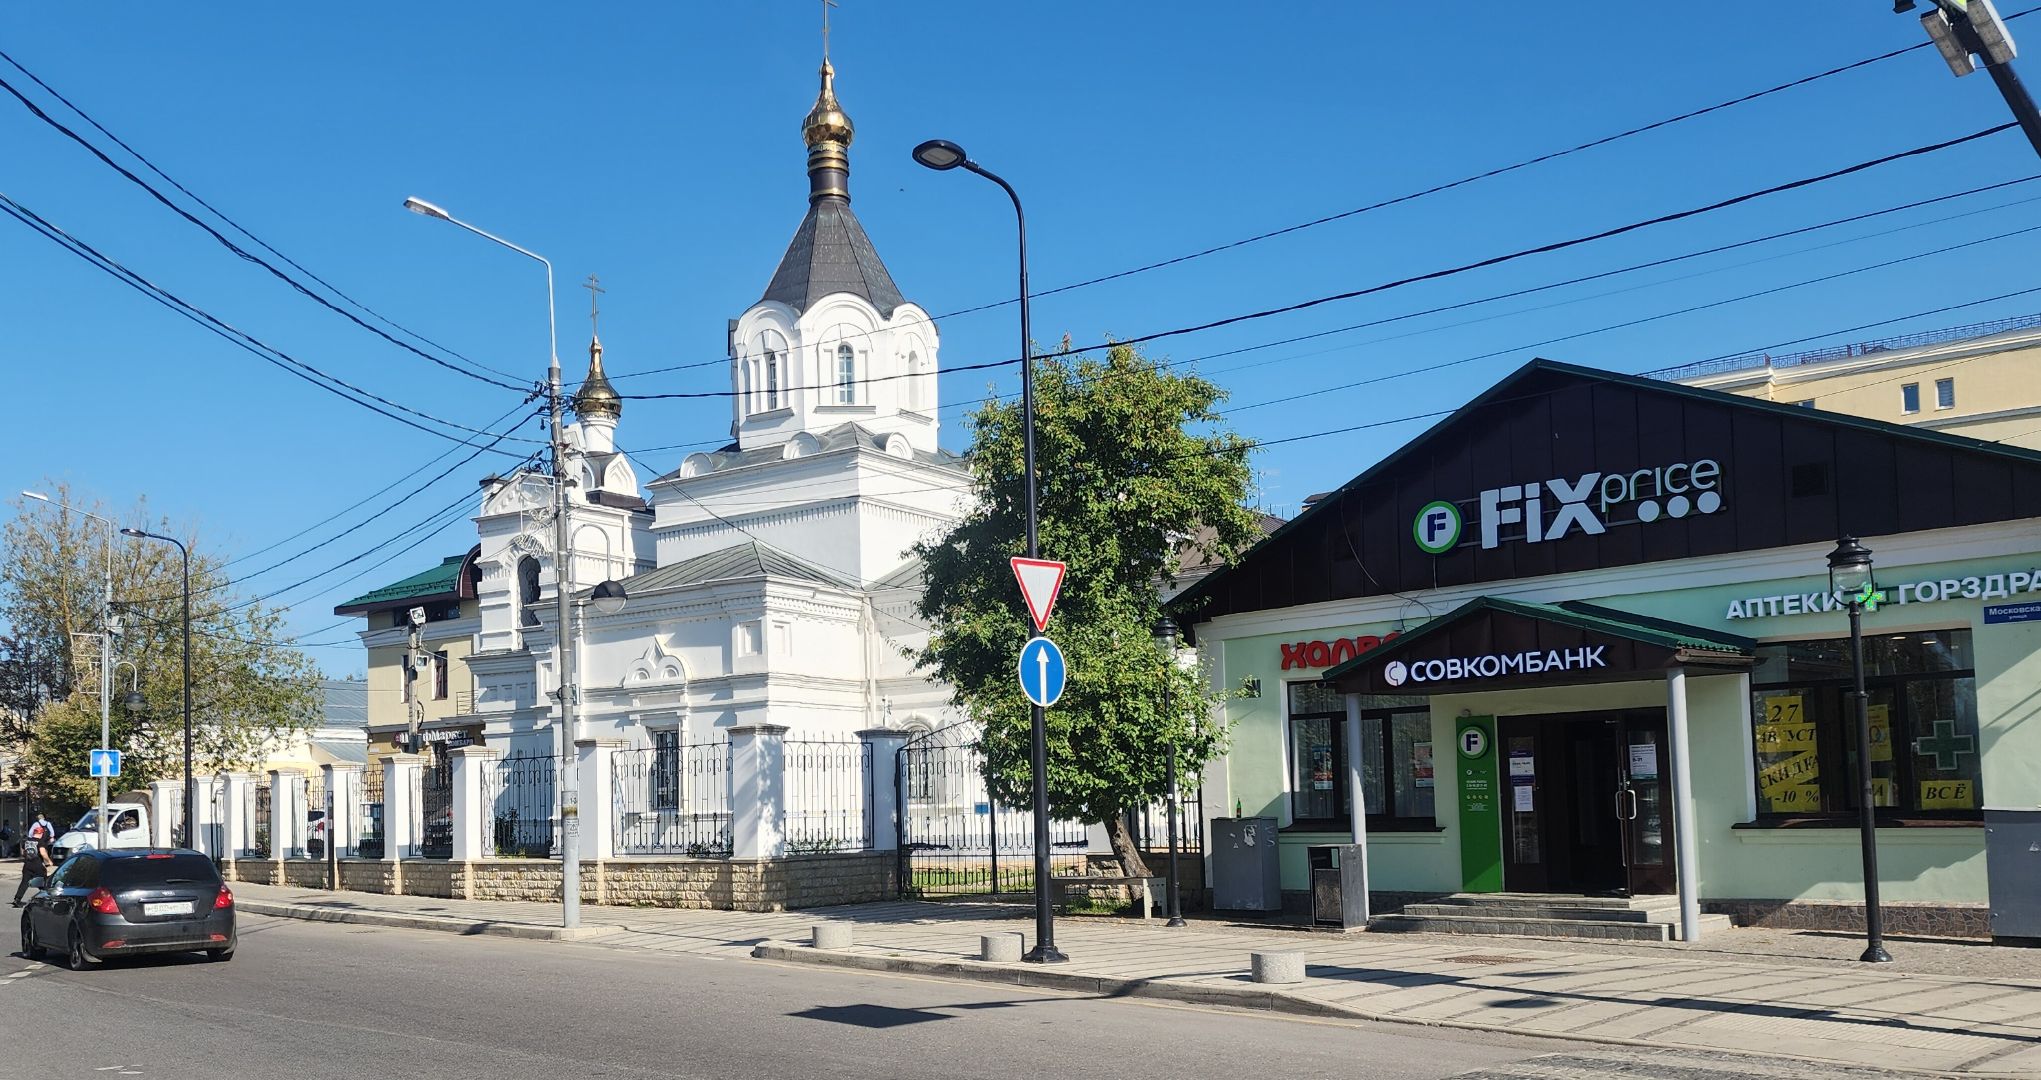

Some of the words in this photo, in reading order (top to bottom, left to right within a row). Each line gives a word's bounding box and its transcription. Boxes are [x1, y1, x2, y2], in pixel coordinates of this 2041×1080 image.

[1726, 590, 1844, 620] АПТЕКИ
[1410, 645, 1607, 682] СОВКОМБАНК
[1770, 703, 1799, 723] 27
[1761, 728, 1816, 744] АВУСТ
[1926, 783, 1967, 800] ВСЁ
